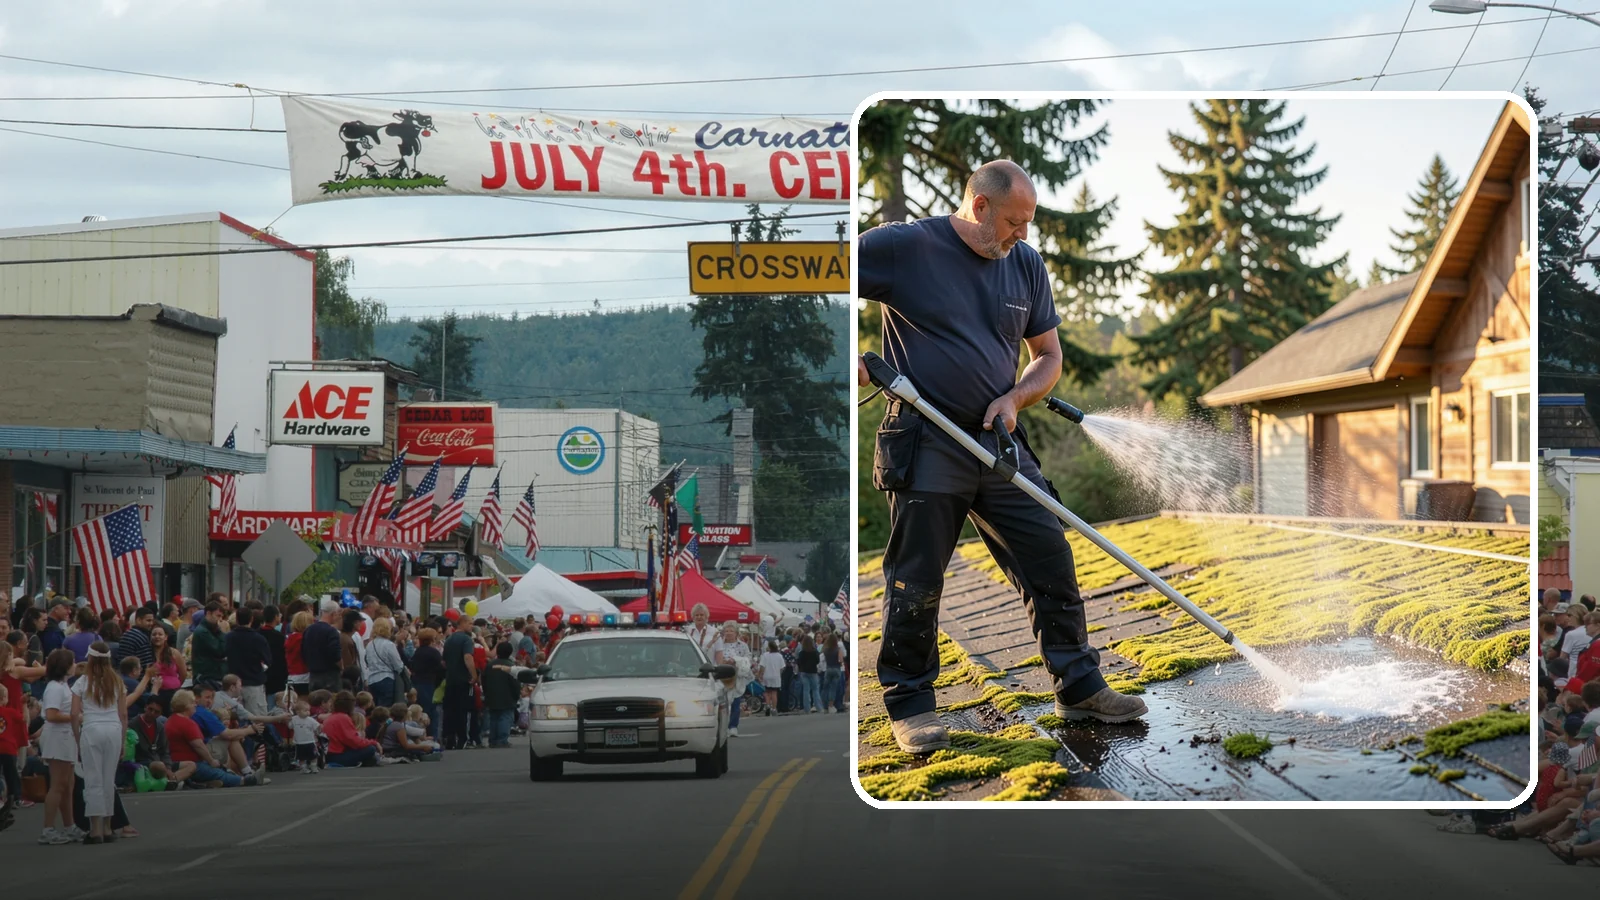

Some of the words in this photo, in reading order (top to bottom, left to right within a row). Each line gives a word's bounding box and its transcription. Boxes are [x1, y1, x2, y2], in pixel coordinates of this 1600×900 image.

[481, 141, 604, 192] JULY
[632, 150, 746, 198] 4th.
[697, 254, 850, 280] CROSSWA
[282, 379, 373, 420] ACE
[405, 409, 453, 422] CEDAR
[461, 409, 485, 422] LOG
[283, 421, 371, 437] Hardware
[95, 485, 124, 495] Vincent
[126, 486, 136, 495] de
[138, 486, 155, 495] Paul
[688, 526, 741, 535] CRNATION
[699, 535, 730, 543] GLASS
